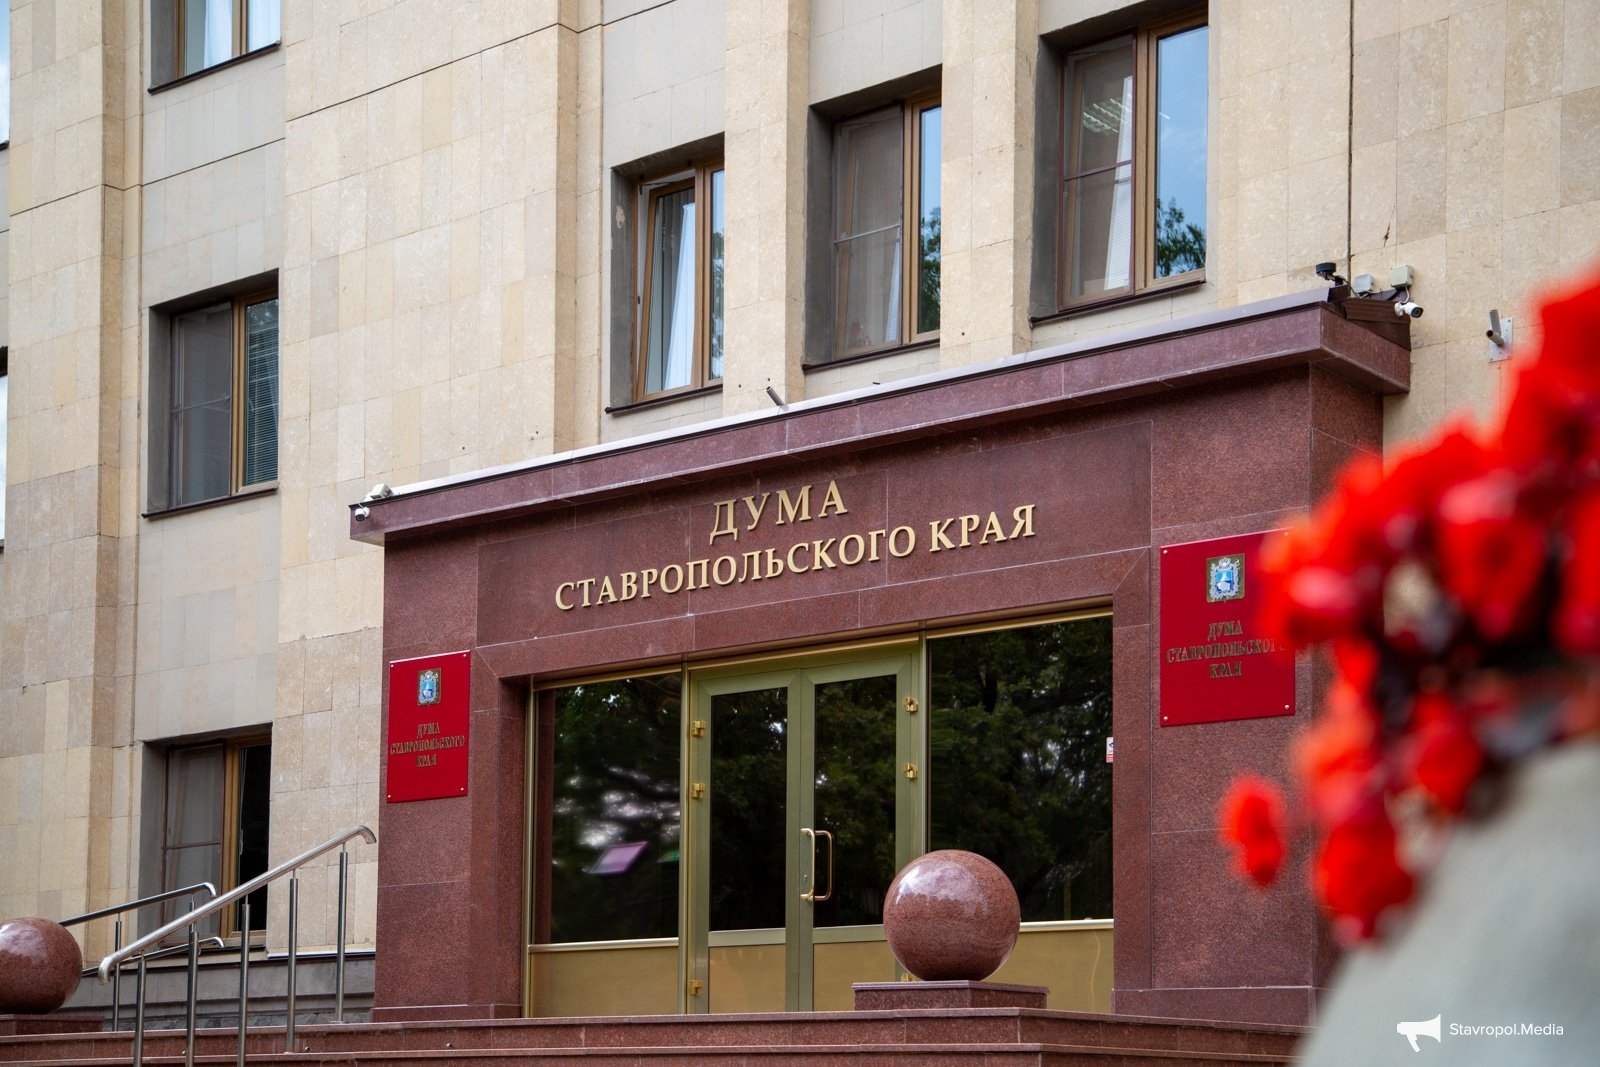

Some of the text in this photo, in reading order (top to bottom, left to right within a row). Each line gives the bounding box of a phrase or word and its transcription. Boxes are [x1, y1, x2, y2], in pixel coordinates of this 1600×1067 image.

[708, 480, 848, 545] ДУМА
[555, 504, 1036, 611] СТАВРОПОЛЬСКОГО КРАЯ
[1207, 620, 1243, 641] ДУМА
[1210, 661, 1242, 679] КРАЯ
[416, 722, 440, 740] ДУМА
[390, 735, 465, 755] СТАВРОПОЛЬСКОГО
[416, 754, 437, 768] КРАЯ
